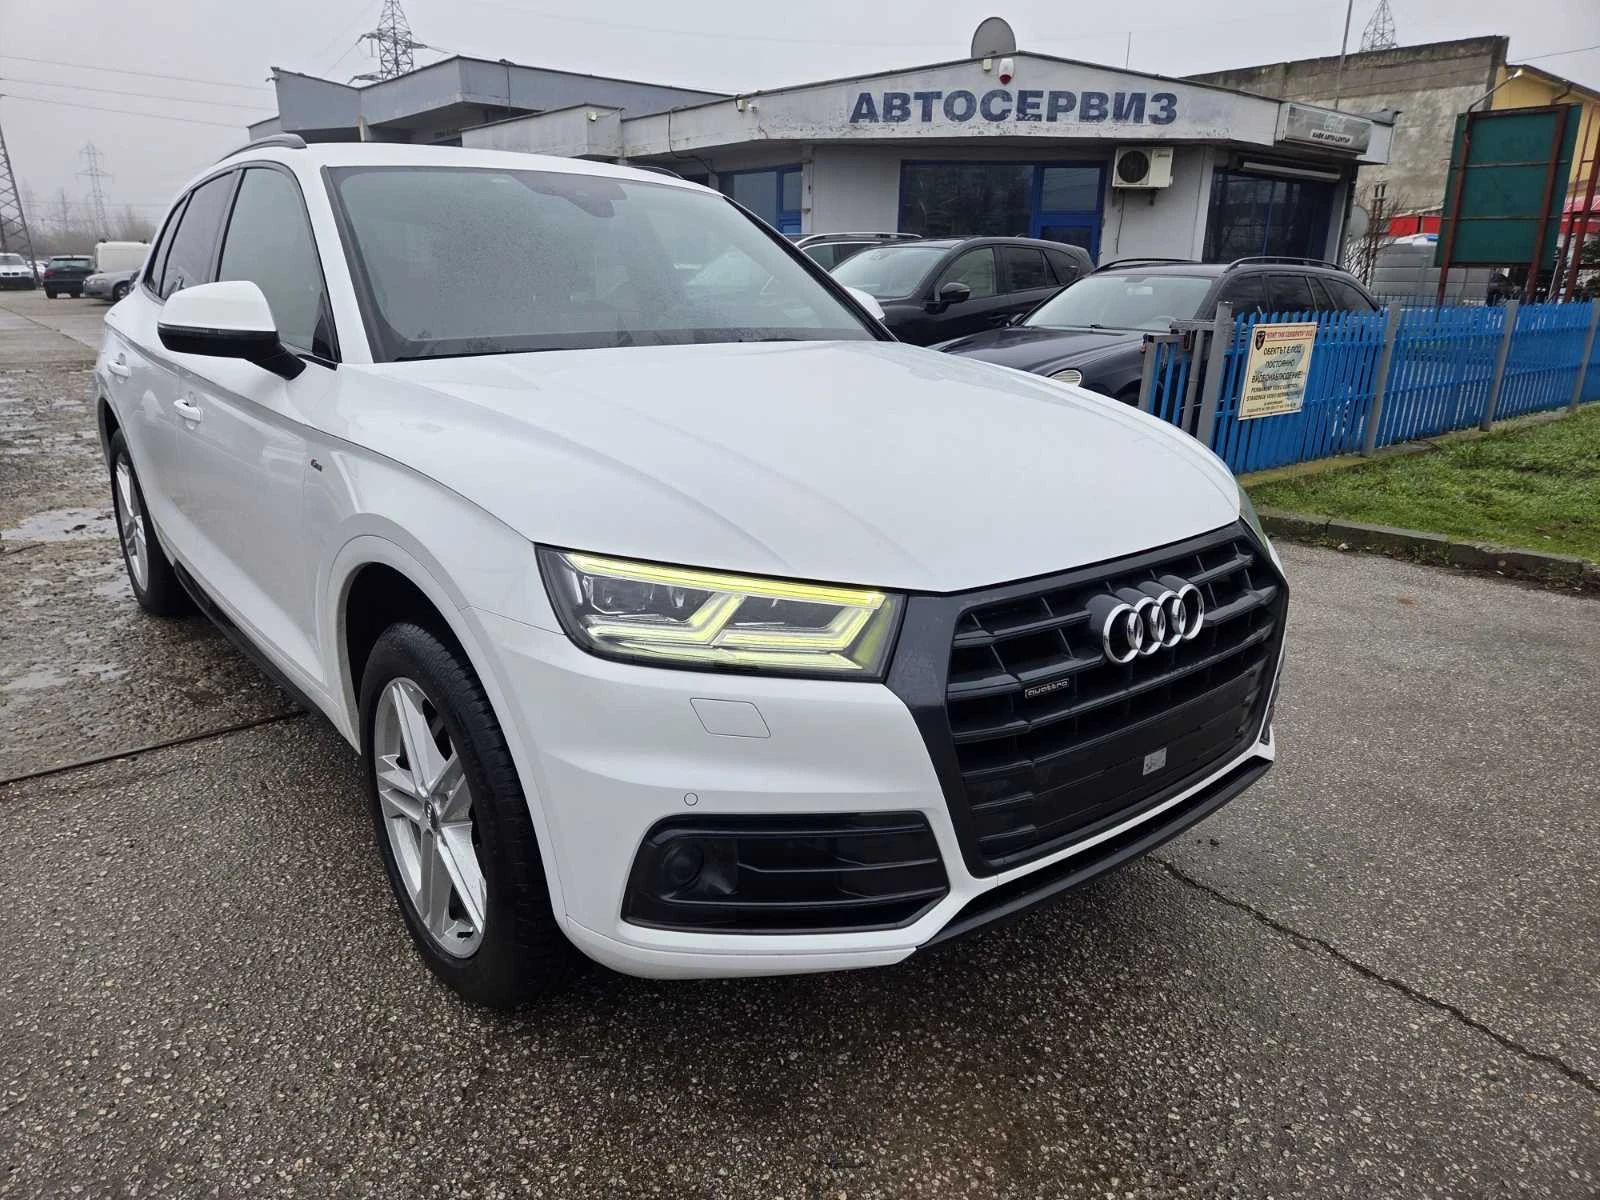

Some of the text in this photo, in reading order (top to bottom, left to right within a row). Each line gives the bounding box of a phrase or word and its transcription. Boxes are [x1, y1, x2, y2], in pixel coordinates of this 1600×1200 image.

[850, 89, 1178, 125] АВТОСЕРВИЗ
[1264, 347, 1286, 355] ОБЕКТЪТ
[1027, 681, 1068, 697] quattro
